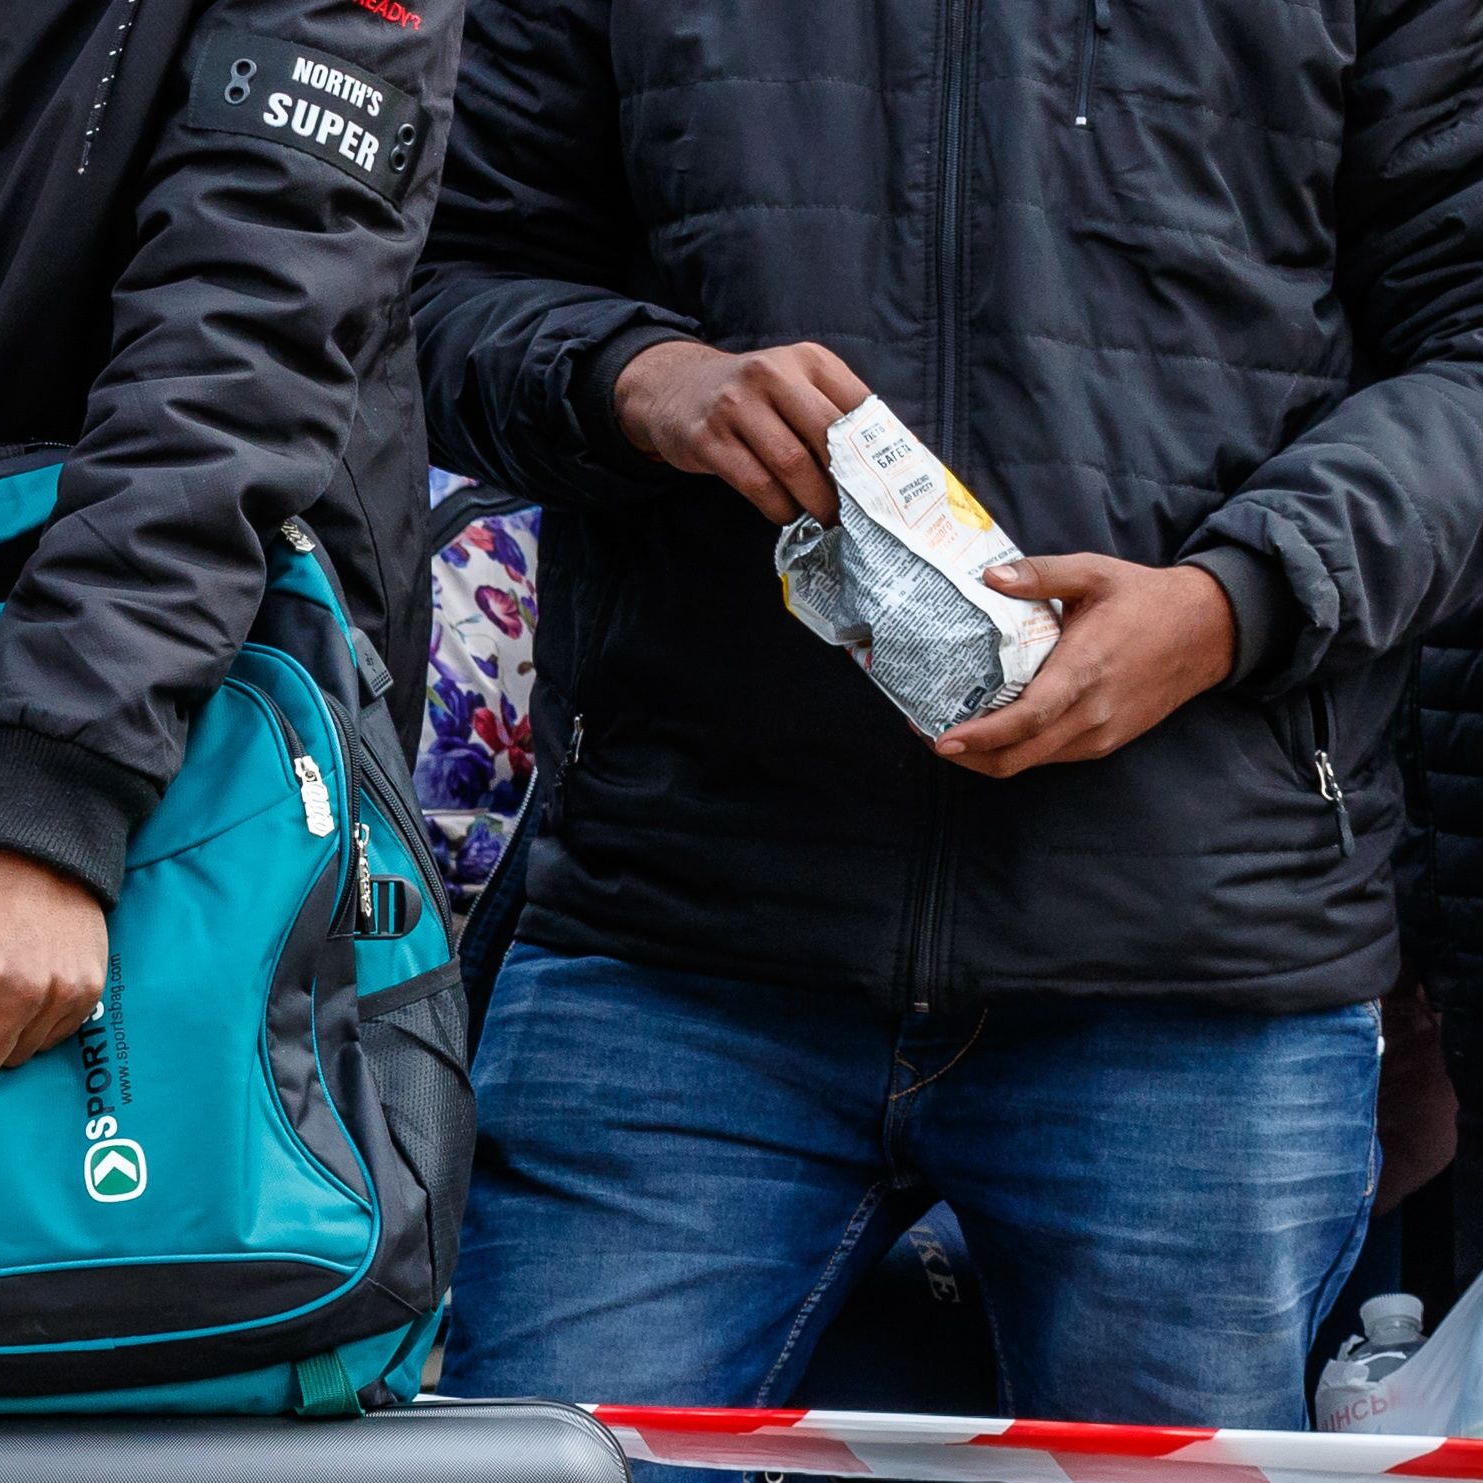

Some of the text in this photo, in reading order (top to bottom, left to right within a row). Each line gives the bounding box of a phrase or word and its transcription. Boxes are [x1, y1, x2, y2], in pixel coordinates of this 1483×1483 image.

[352, 0, 423, 30] EADY?
[291, 56, 383, 117] NORTH'S
[263, 92, 380, 173] SUPER
[108, 952, 133, 1106] www.sportsbag.com
